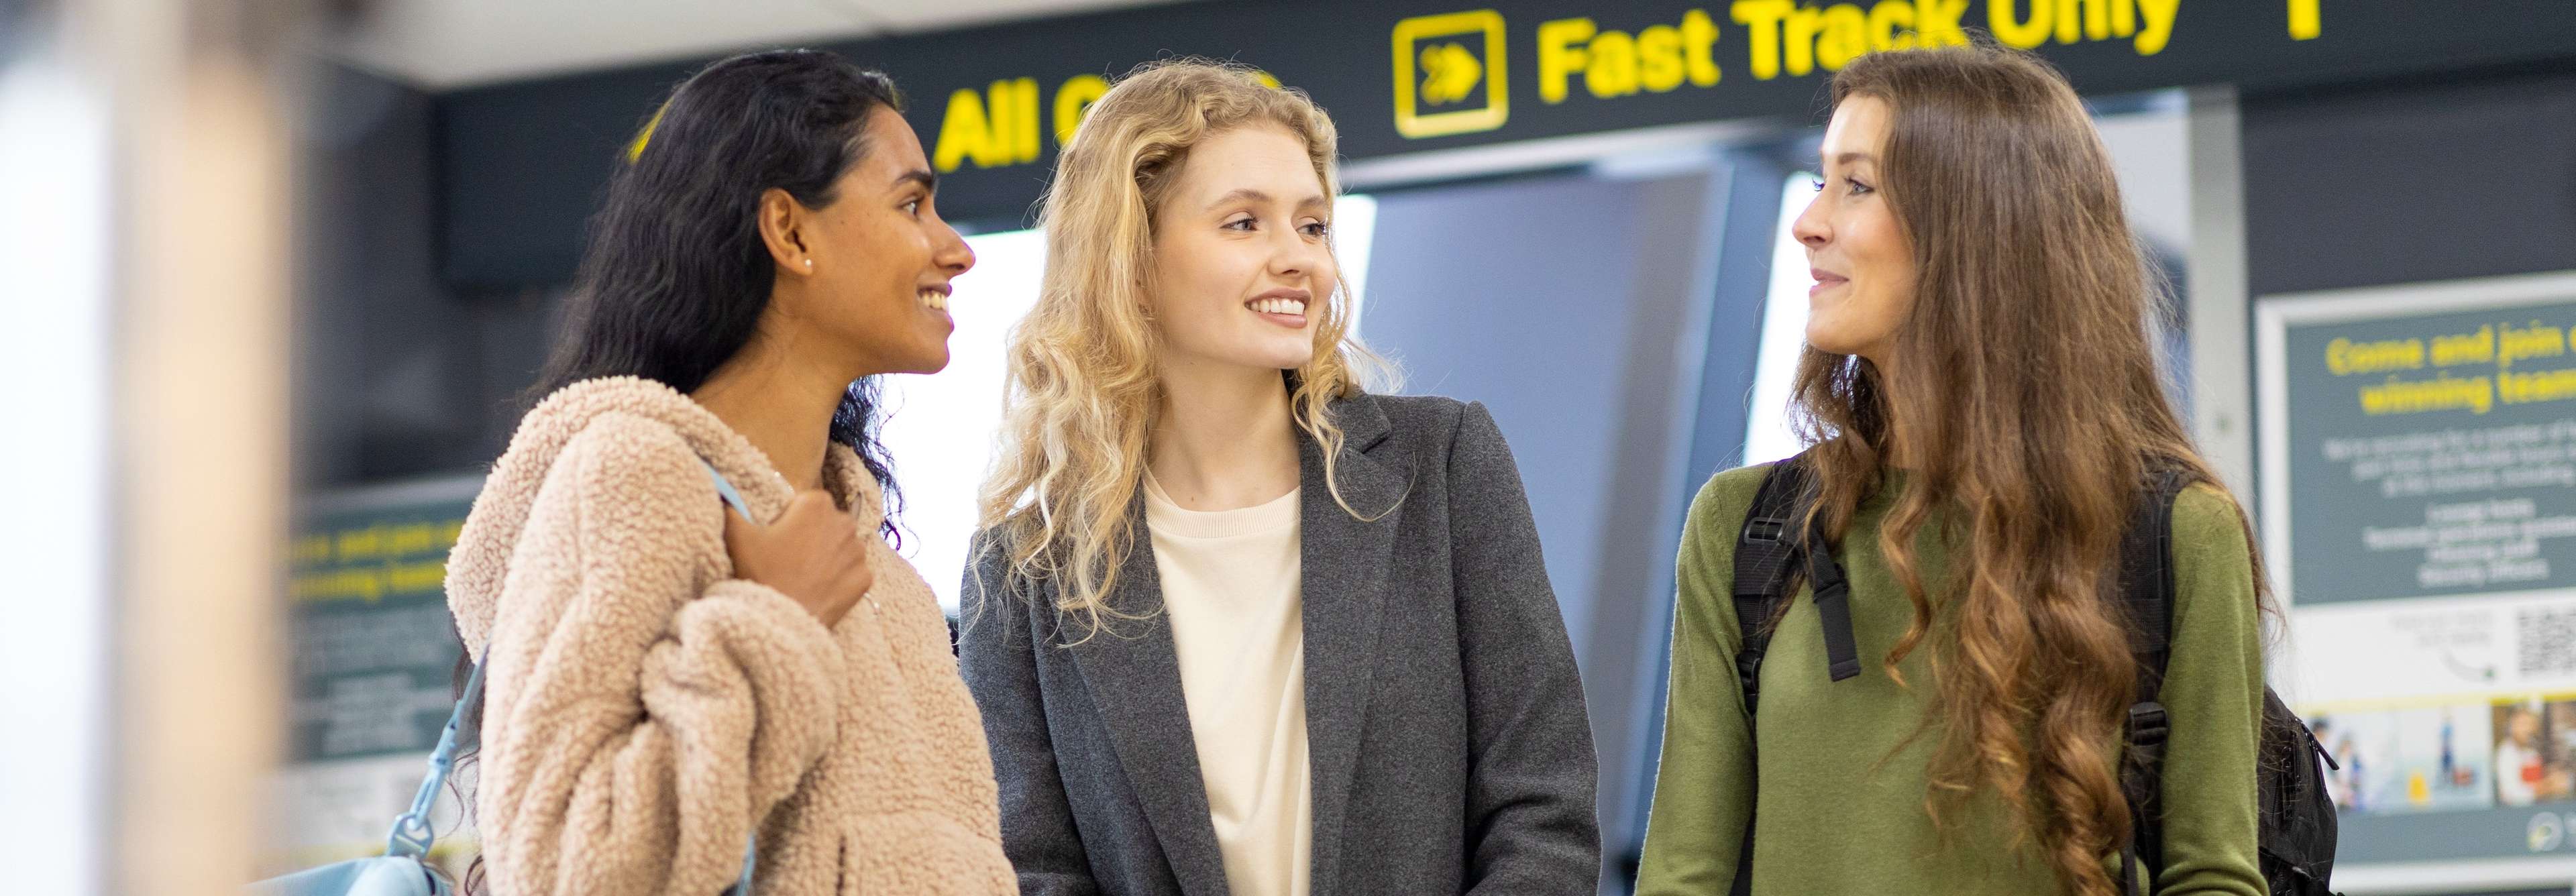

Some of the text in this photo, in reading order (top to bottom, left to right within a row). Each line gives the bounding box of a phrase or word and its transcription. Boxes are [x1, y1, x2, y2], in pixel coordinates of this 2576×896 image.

[1537, 9, 1721, 103] Fast
[1730, 0, 1971, 80] Track
[933, 78, 1040, 172] All
[2326, 337, 2424, 376] Come
[2430, 324, 2494, 367] and
